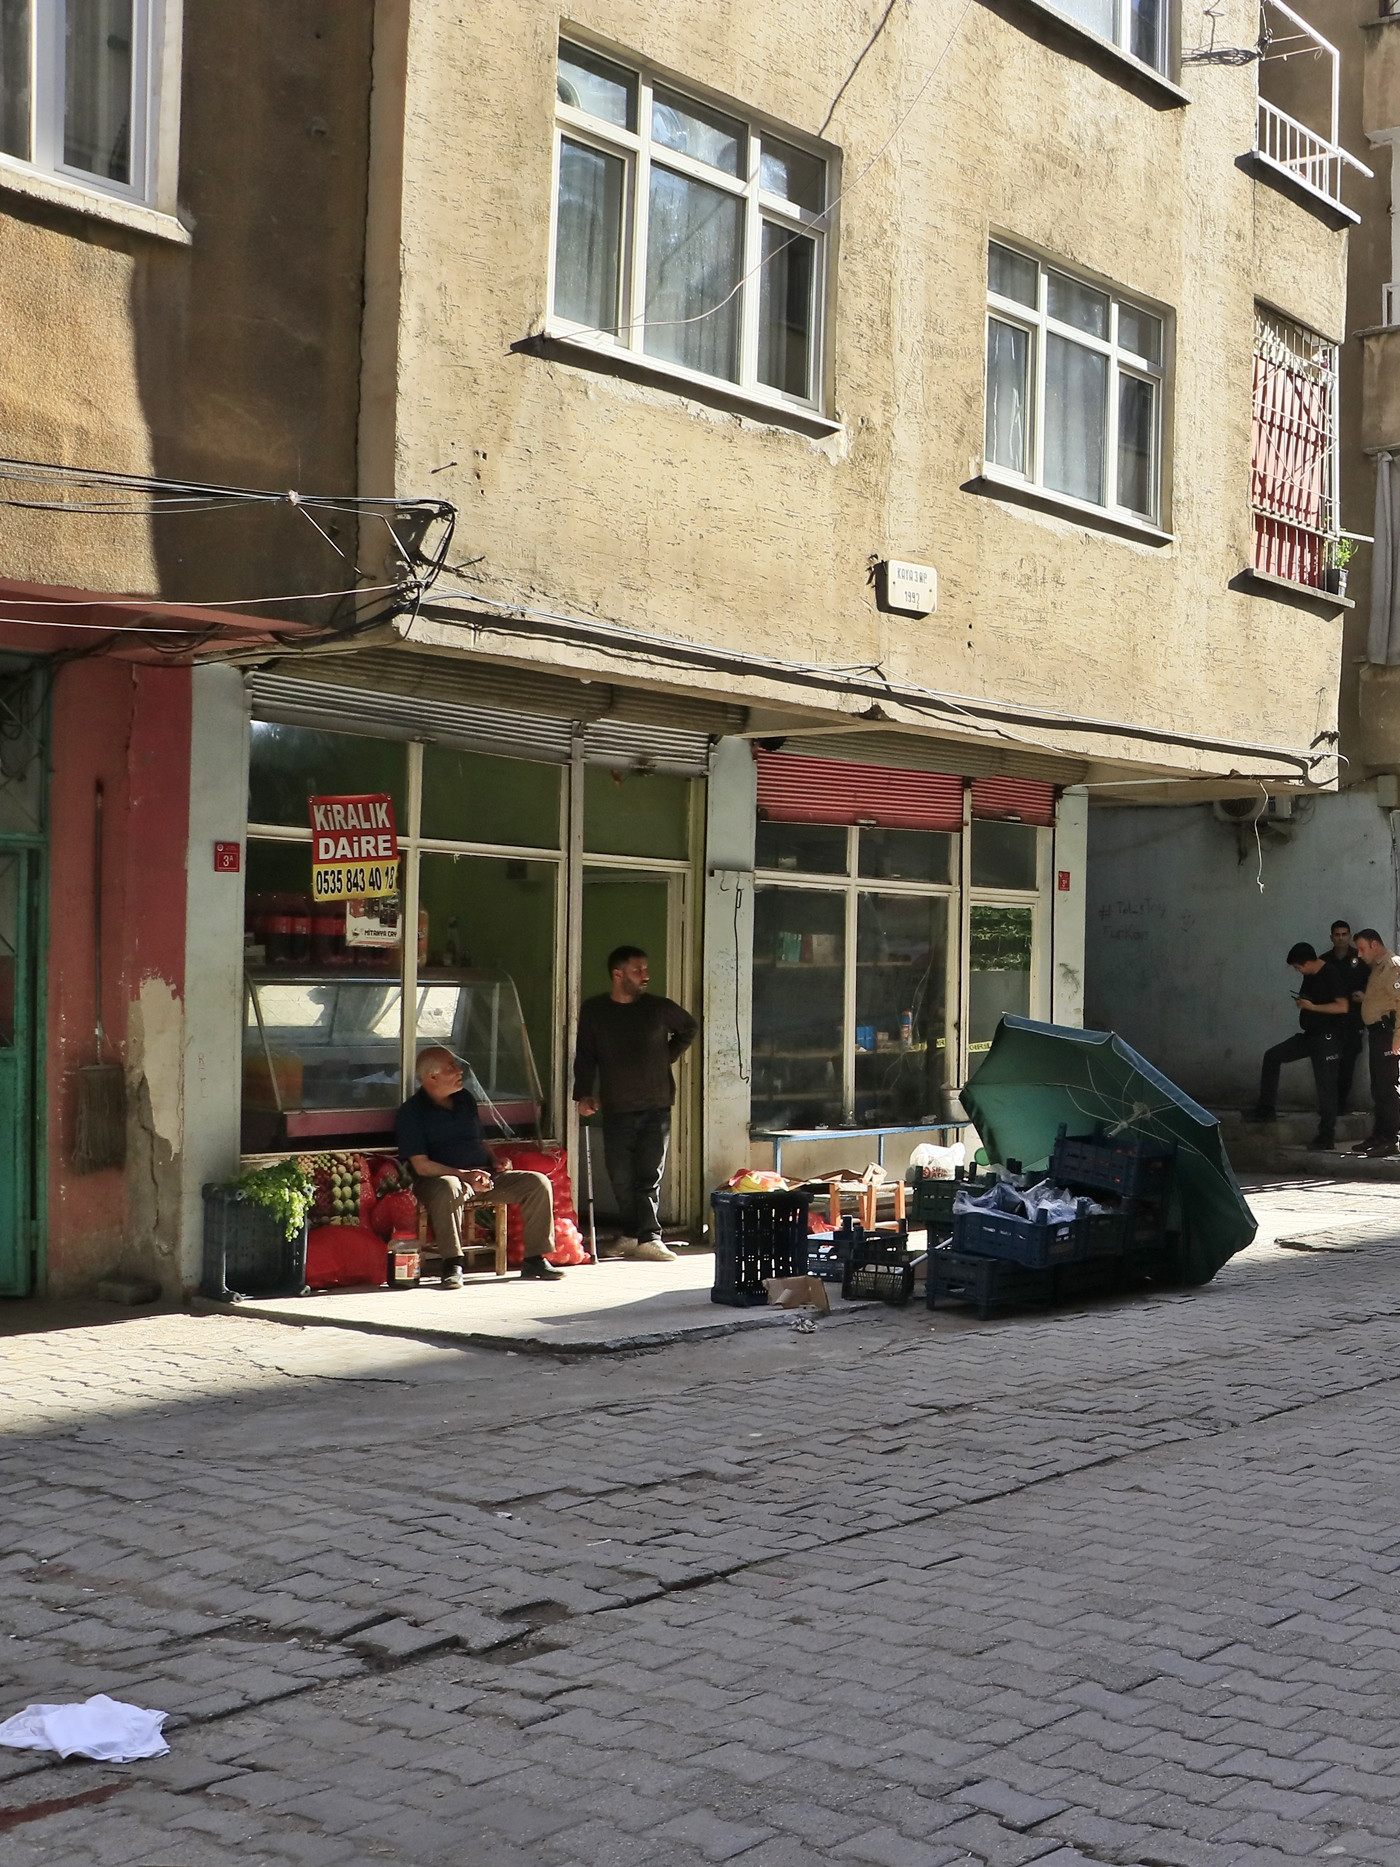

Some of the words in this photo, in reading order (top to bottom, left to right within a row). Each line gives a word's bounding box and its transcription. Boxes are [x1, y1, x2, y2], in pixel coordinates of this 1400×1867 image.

[316, 869, 343, 895] 0535
[346, 868, 366, 893] 843
[368, 867, 382, 891] 40
